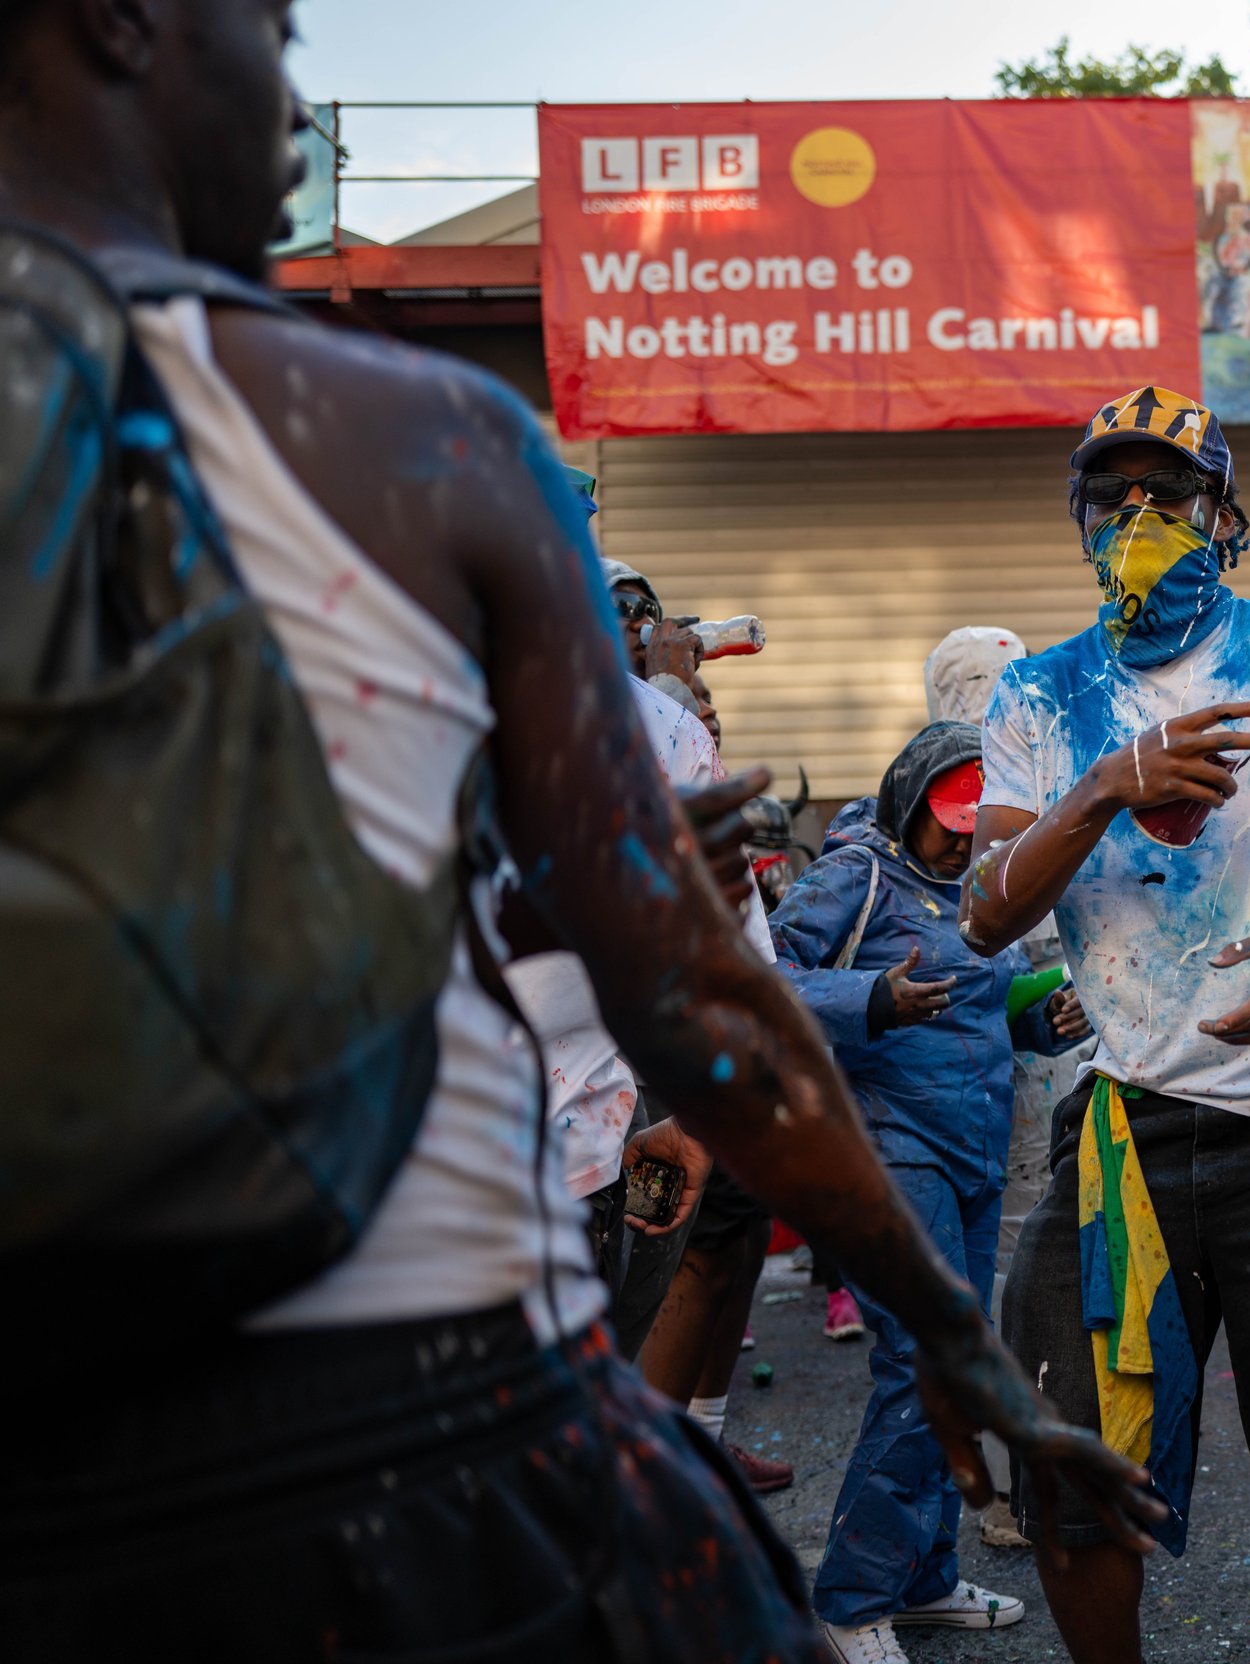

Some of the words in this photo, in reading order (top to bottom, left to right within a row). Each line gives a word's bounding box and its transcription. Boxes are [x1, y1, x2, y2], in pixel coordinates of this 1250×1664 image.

[582, 197, 650, 214] LONDON
[691, 193, 758, 212] BRIGADE
[581, 249, 838, 294] Welcome
[852, 248, 911, 290] to
[584, 312, 799, 366] Notting
[814, 308, 910, 354] Hill
[926, 304, 1159, 351] Carnival
